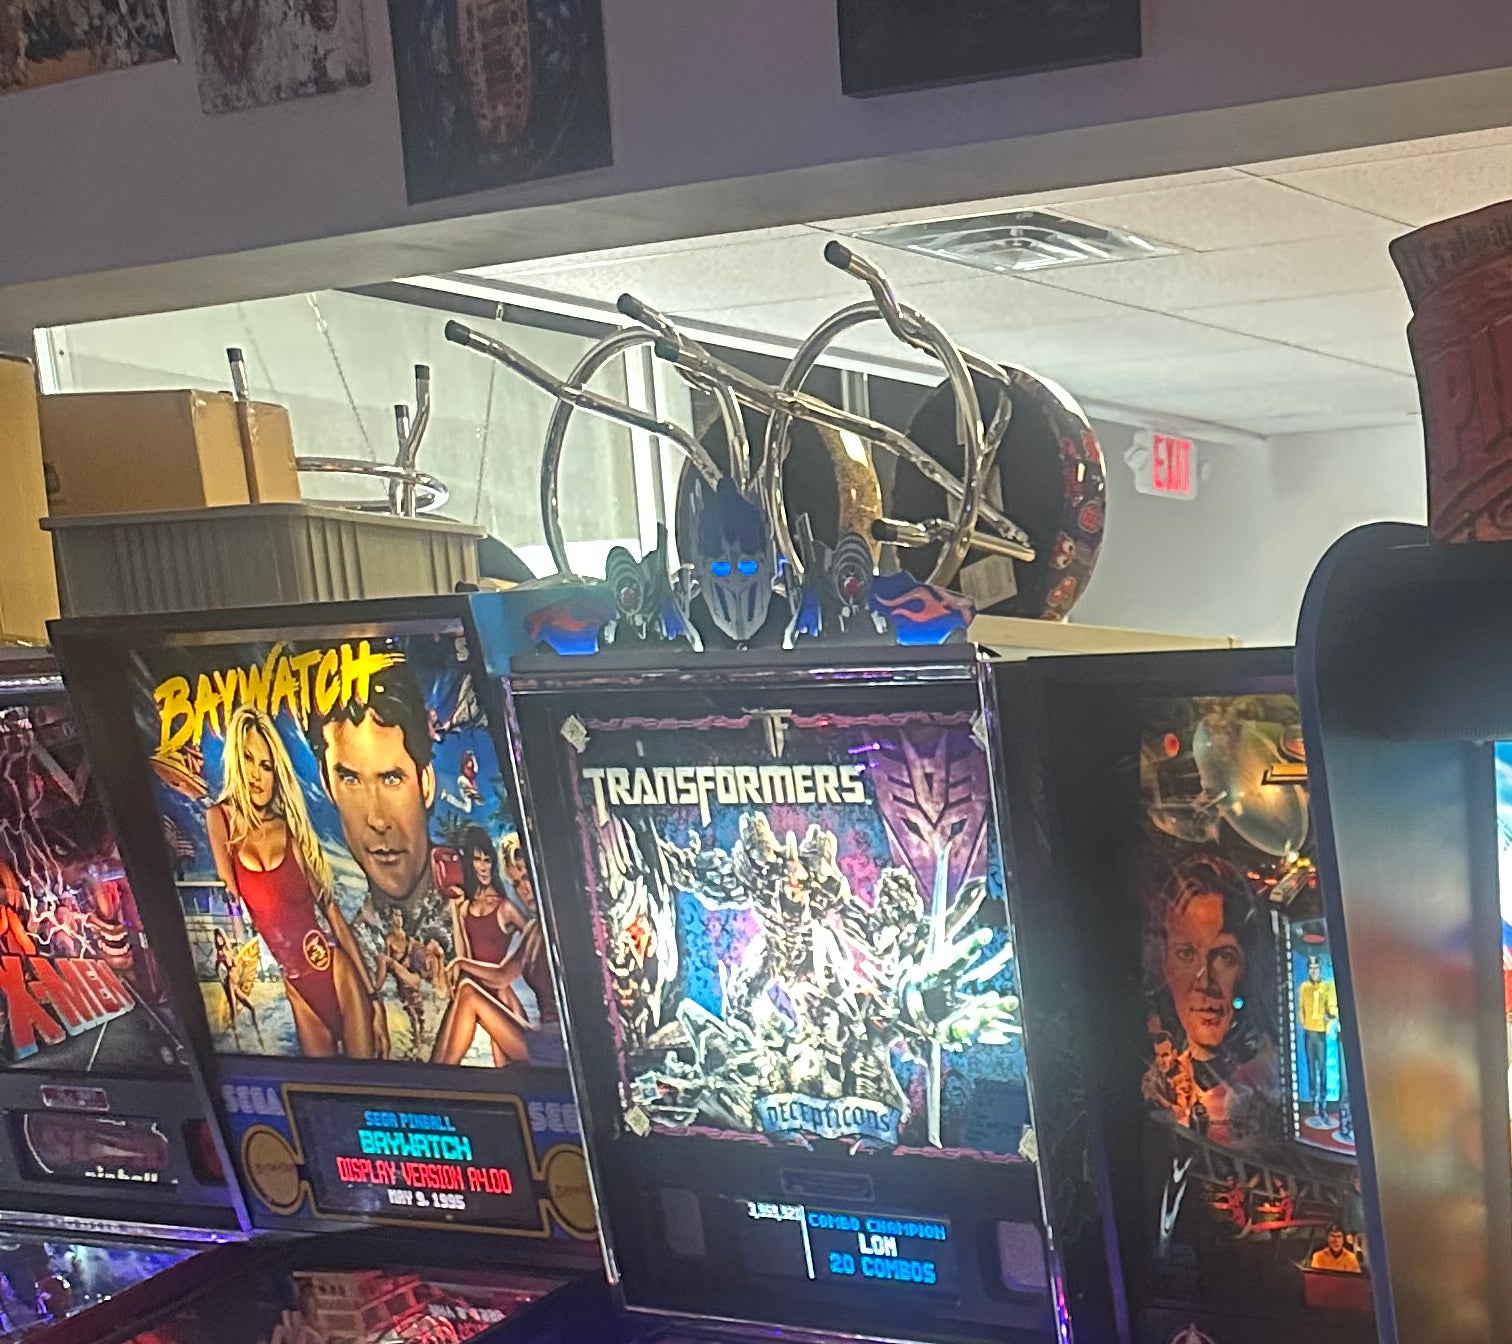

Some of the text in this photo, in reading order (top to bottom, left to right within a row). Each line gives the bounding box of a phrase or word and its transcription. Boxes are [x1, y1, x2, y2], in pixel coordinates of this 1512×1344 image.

[154, 639, 405, 754] BAYWATCH
[582, 764, 866, 828] TRANSFORMERS
[223, 1084, 285, 1117] SEGA
[364, 1110, 457, 1132] SEGA PINBALL
[358, 1129, 474, 1161] BAYWATCH
[336, 1156, 398, 1186] DISPLAY
[400, 1161, 464, 1191] VERSION
[808, 1212, 947, 1241] COMBO CHAMPION
[857, 1232, 899, 1257] LOM
[829, 1250, 938, 1284] 20 COMBOS
